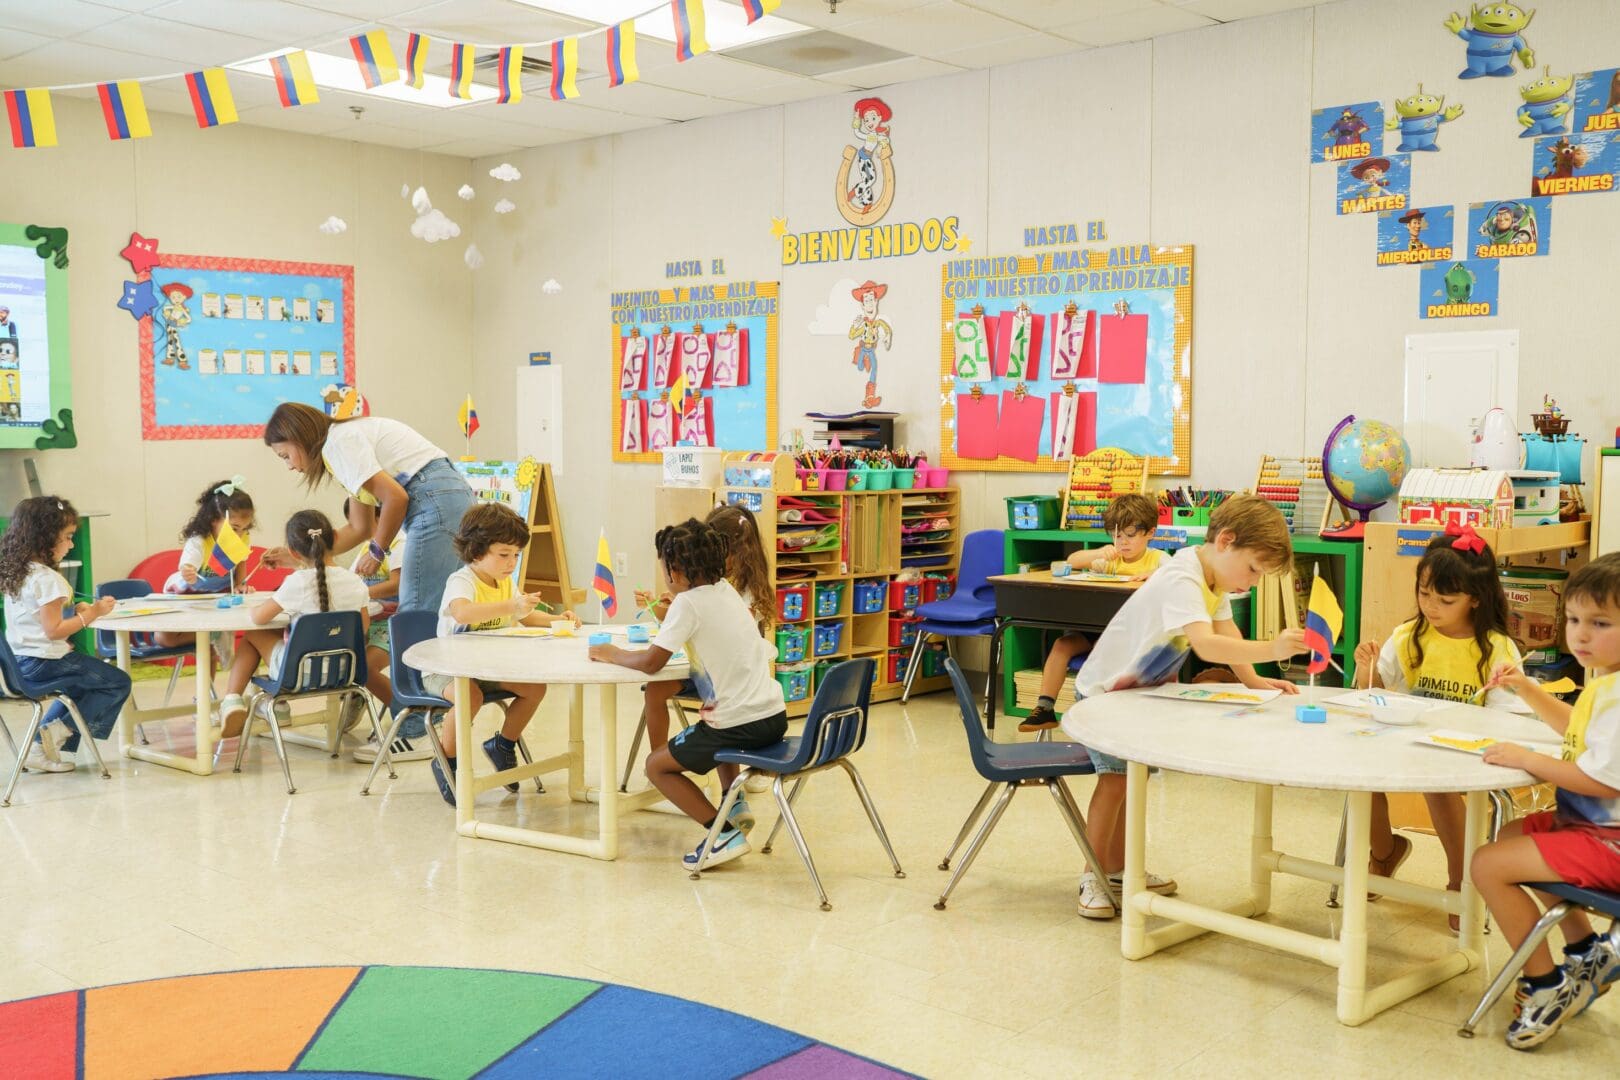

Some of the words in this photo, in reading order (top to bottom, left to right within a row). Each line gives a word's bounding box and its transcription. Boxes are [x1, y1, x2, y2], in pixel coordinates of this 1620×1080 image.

[1583, 112, 1620, 132] JUE
[1324, 142, 1371, 161] LUNES
[1538, 173, 1613, 195] VIERNES
[1342, 194, 1406, 214] MARTES
[782, 216, 958, 266] BIENVENIDOS
[1024, 223, 1077, 247] HASTA
[1086, 221, 1106, 240] EL
[1377, 247, 1452, 265] MIERCOLES
[1478, 243, 1537, 258] SABADO
[666, 260, 702, 278] HASTA
[711, 259, 725, 274] EL
[947, 256, 1018, 278] INFINITO
[1034, 253, 1046, 272] Y
[1052, 249, 1090, 270] MAS
[1107, 245, 1151, 267] ALLA
[945, 279, 978, 299] CON
[985, 276, 1060, 298] NUESTRO
[1064, 266, 1190, 294] APRENDIZAJE
[611, 290, 660, 308] INFINITO
[673, 287, 681, 302] Y
[689, 284, 716, 301] MAS
[727, 281, 757, 298] ALLA
[611, 307, 635, 324] CON
[640, 304, 691, 324] NUESTRO
[693, 298, 777, 320] APRENDIZAJE
[1427, 303, 1490, 318] DOMINGO
[1462, 684, 1478, 696] EN
